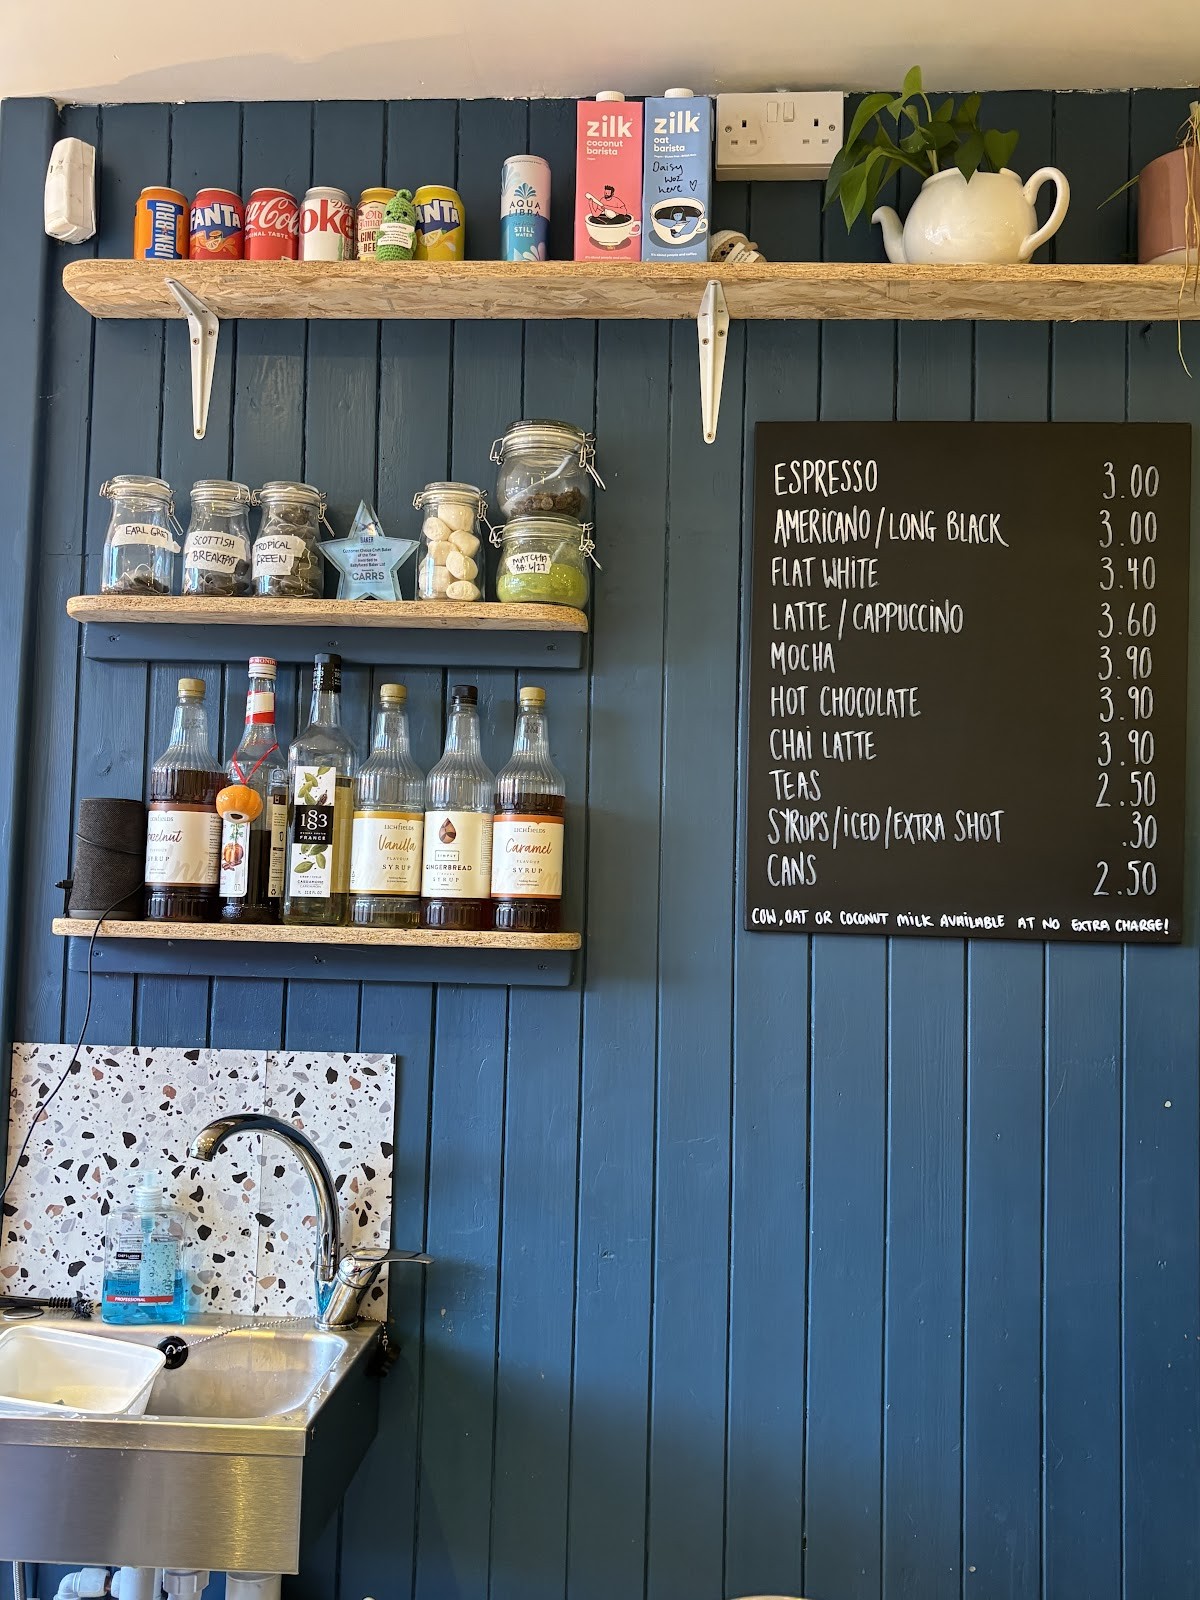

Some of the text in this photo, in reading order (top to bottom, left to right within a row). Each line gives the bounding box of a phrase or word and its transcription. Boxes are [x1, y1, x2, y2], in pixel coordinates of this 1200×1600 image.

[586, 115, 633, 138] zilk
[653, 111, 701, 134] zilk
[586, 140, 624, 148] coconut
[586, 147, 619, 156] barista
[653, 144, 686, 153] barista
[652, 161, 684, 176] Daisy
[658, 185, 683, 194] here
[415, 199, 460, 224] ANTA
[508, 209, 541, 218] LIBRA
[509, 200, 541, 210] AQUA
[190, 203, 242, 232] FANTA
[300, 198, 354, 240] oke
[268, 231, 289, 240] TASTE
[360, 230, 377, 243] GING
[514, 226, 535, 234] STILL
[363, 243, 377, 253] BEE
[774, 459, 1160, 499] ESPRESSO 3.00
[125, 525, 148, 535] EARL
[946, 510, 1010, 548] BLACK
[1099, 509, 1157, 548] 3.00
[193, 535, 236, 549] SCOTTISH
[256, 539, 292, 551] TROPICAL
[772, 555, 1156, 591] FLAT WHITE 3.40
[1098, 602, 1157, 639] 3.60
[770, 640, 1152, 681] MOCHA 3.90
[770, 685, 1154, 723] HOT CHOCOLATE 3.90
[769, 725, 1155, 767] CHAI LATTE 3.90
[768, 769, 1156, 808] TEAS 2.50
[953, 809, 1005, 843] SHOT
[1122, 810, 1158, 849] .30
[378, 834, 417, 853] Vanilla
[505, 837, 553, 855] Caramel
[767, 851, 1157, 896] CANS 2.50
[814, 910, 834, 925] OR
[839, 910, 890, 926] COCONUT
[896, 911, 935, 928] MILK
[939, 911, 1005, 930] AVAILABLE
[1017, 916, 1036, 931] AT
[1041, 916, 1061, 930] NO
[1070, 917, 1111, 932] EXTRA
[1114, 917, 1169, 935] CHARGE!
